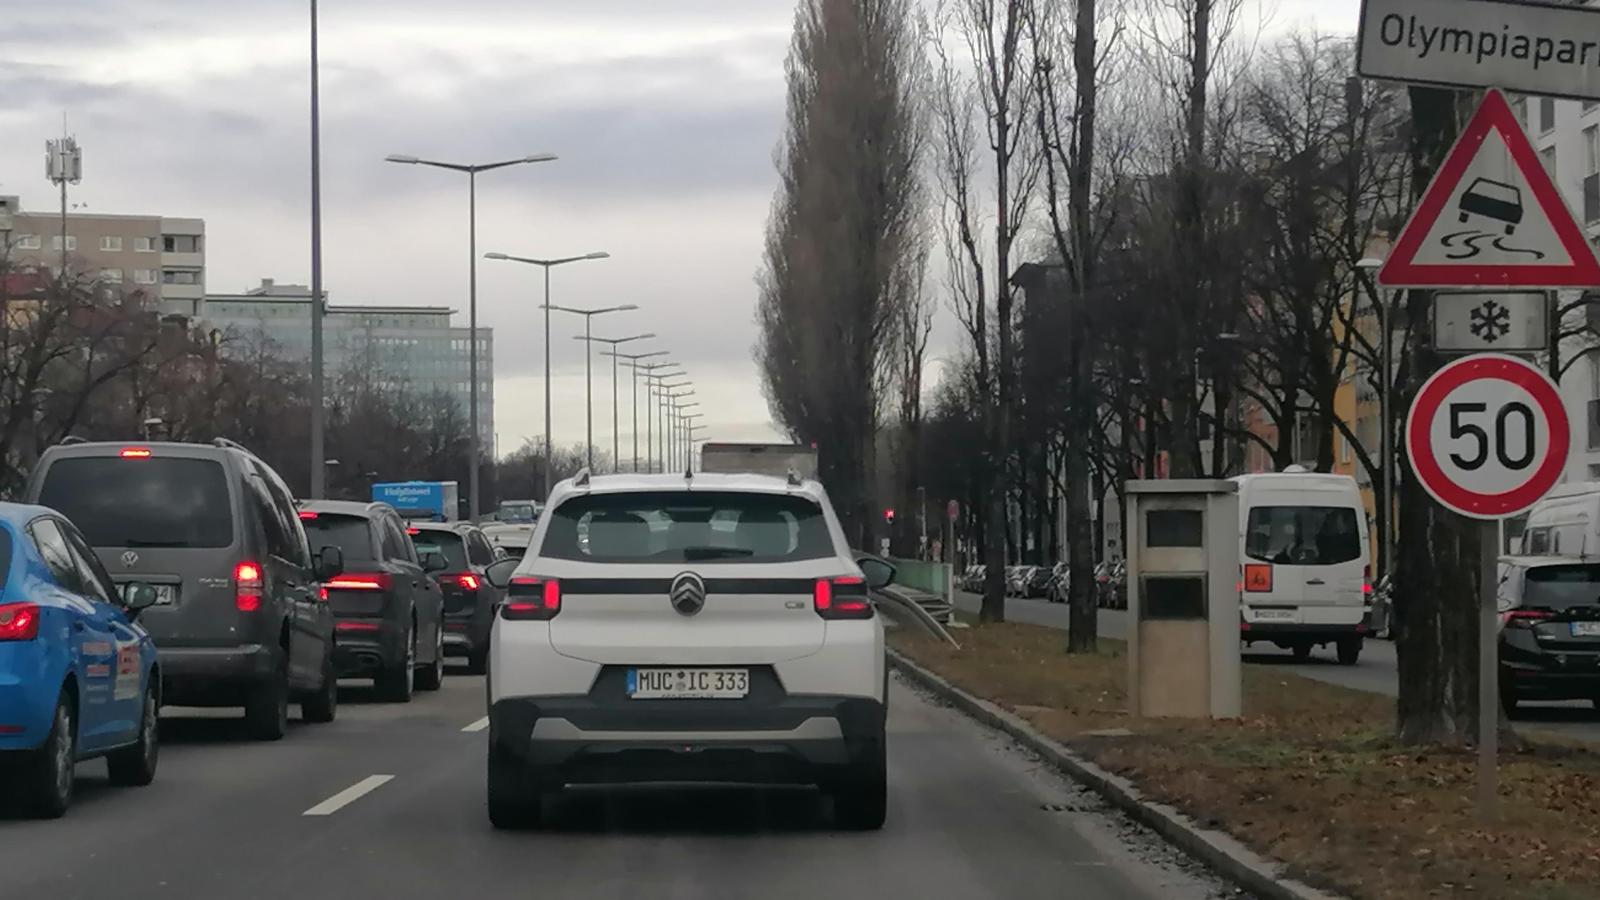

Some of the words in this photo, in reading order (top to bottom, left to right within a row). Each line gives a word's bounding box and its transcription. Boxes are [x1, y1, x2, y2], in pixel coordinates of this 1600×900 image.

[1380, 13, 1600, 69] Olympiapar
[1449, 401, 1536, 471] 50
[639, 672, 673, 691] MUC
[688, 672, 709, 691] IC
[714, 672, 747, 691] 333
